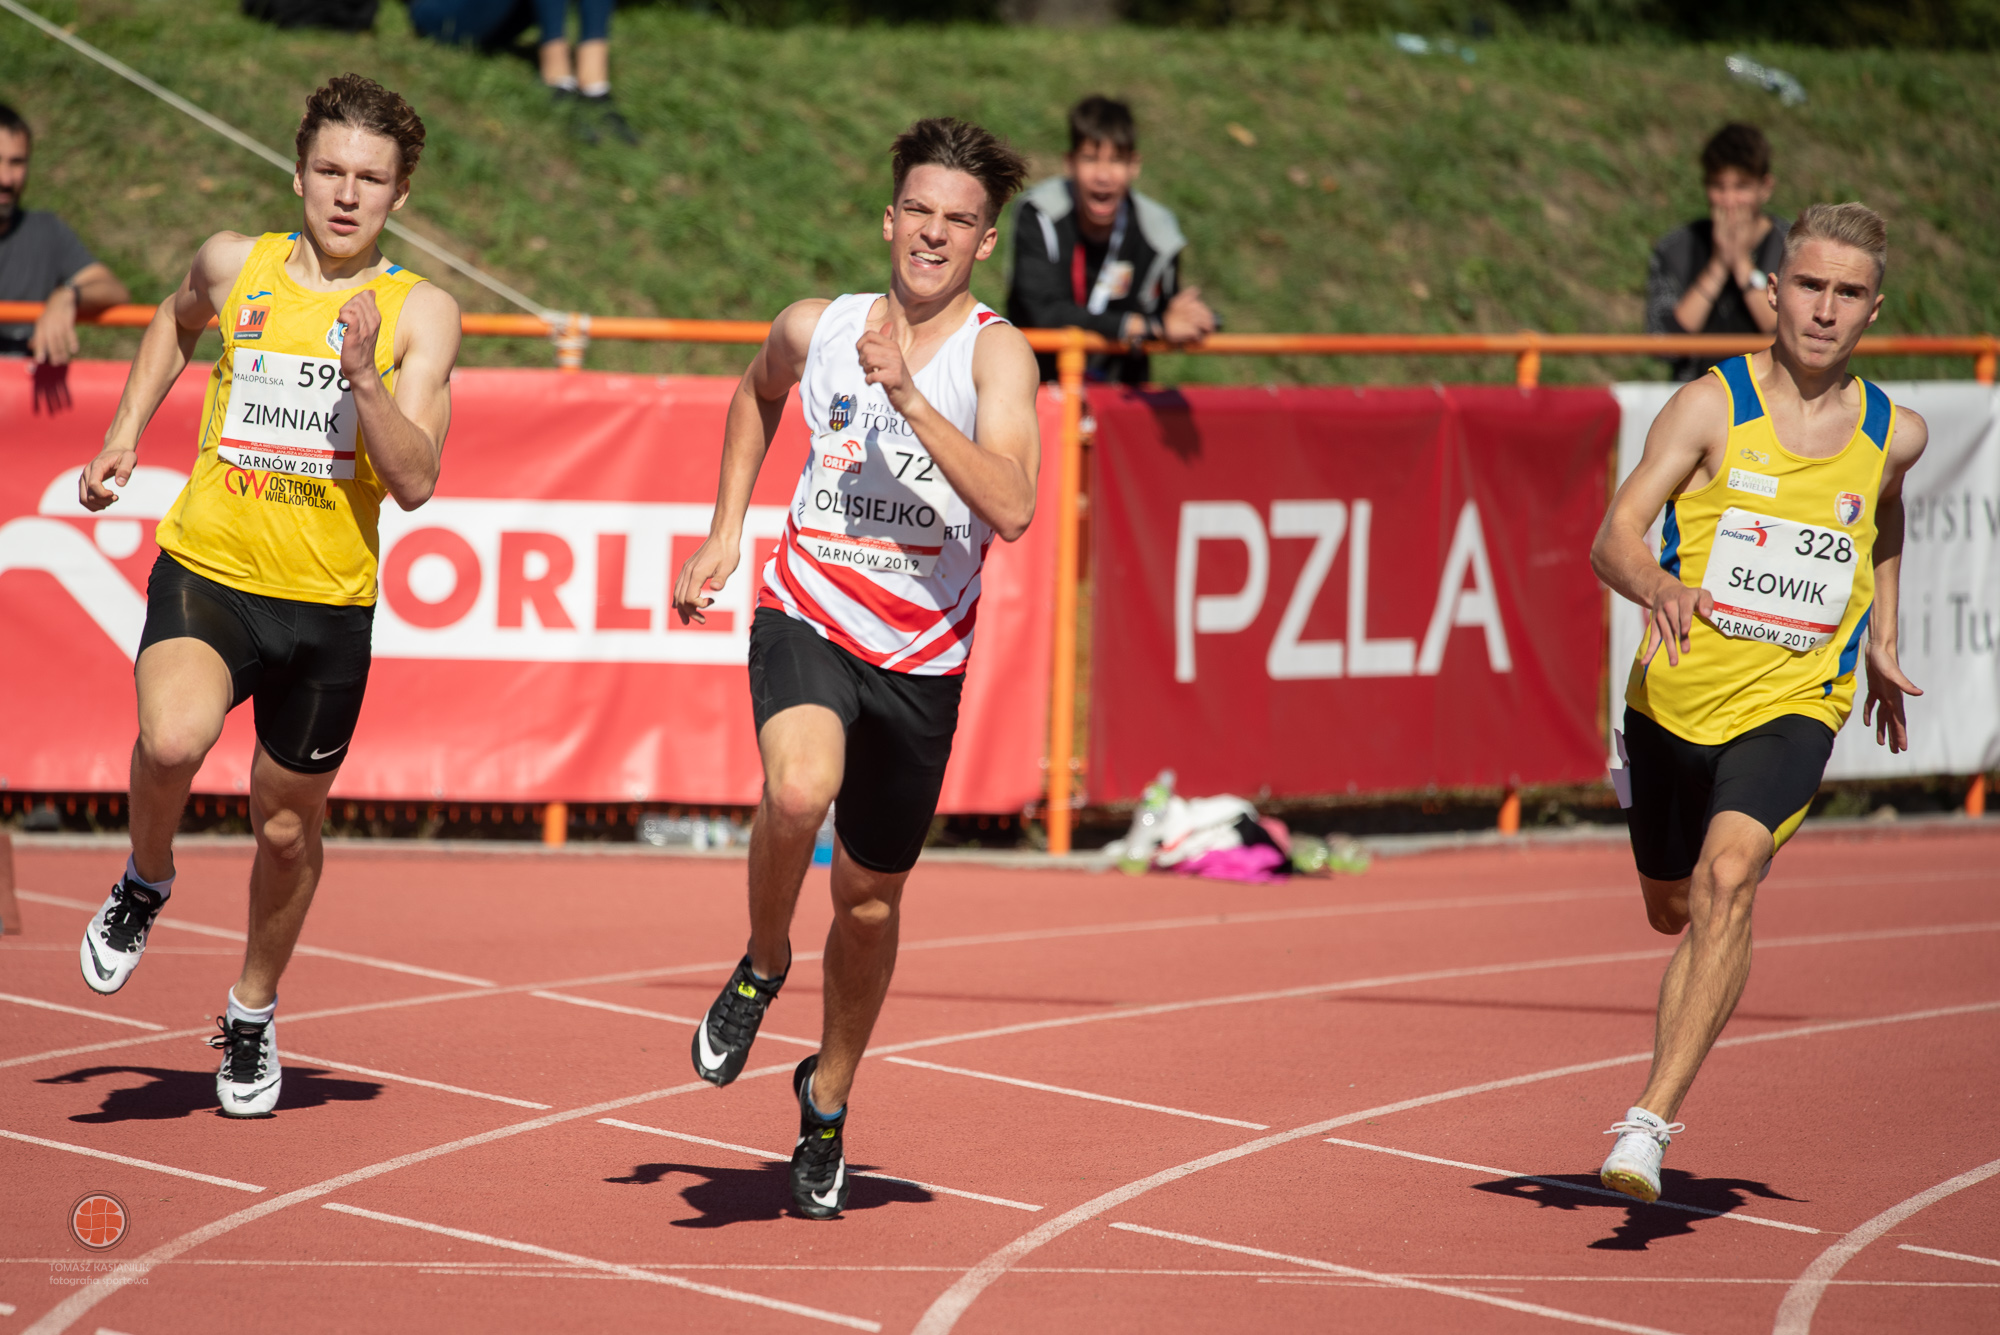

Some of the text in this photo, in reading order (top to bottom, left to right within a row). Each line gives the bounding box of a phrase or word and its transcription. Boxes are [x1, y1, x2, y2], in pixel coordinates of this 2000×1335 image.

[239, 309, 265, 326] BM
[234, 372, 284, 386] MAŁOPOLSKA
[297, 361, 352, 392] 598
[242, 402, 340, 434] ZIMNIAK
[238, 454, 334, 475] TARNÓW 2019
[824, 455, 860, 472] ORLEN
[895, 451, 934, 482] 72
[265, 490, 336, 511] WIELKOPOLSKI
[269, 476, 326, 499] OSTRÓW
[1741, 481, 1777, 495] WIELICKI
[815, 489, 936, 528] OLISIEJKO
[1720, 528, 1757, 544] polanik
[1795, 529, 1852, 564] 328
[817, 545, 880, 567] TARNÓW
[884, 557, 920, 571] 2019
[382, 526, 780, 632] ORLE
[1175, 498, 1513, 683] PZLA
[1728, 566, 1828, 606] SŁOWIK
[1717, 617, 1816, 649] TARNÓW 2019
